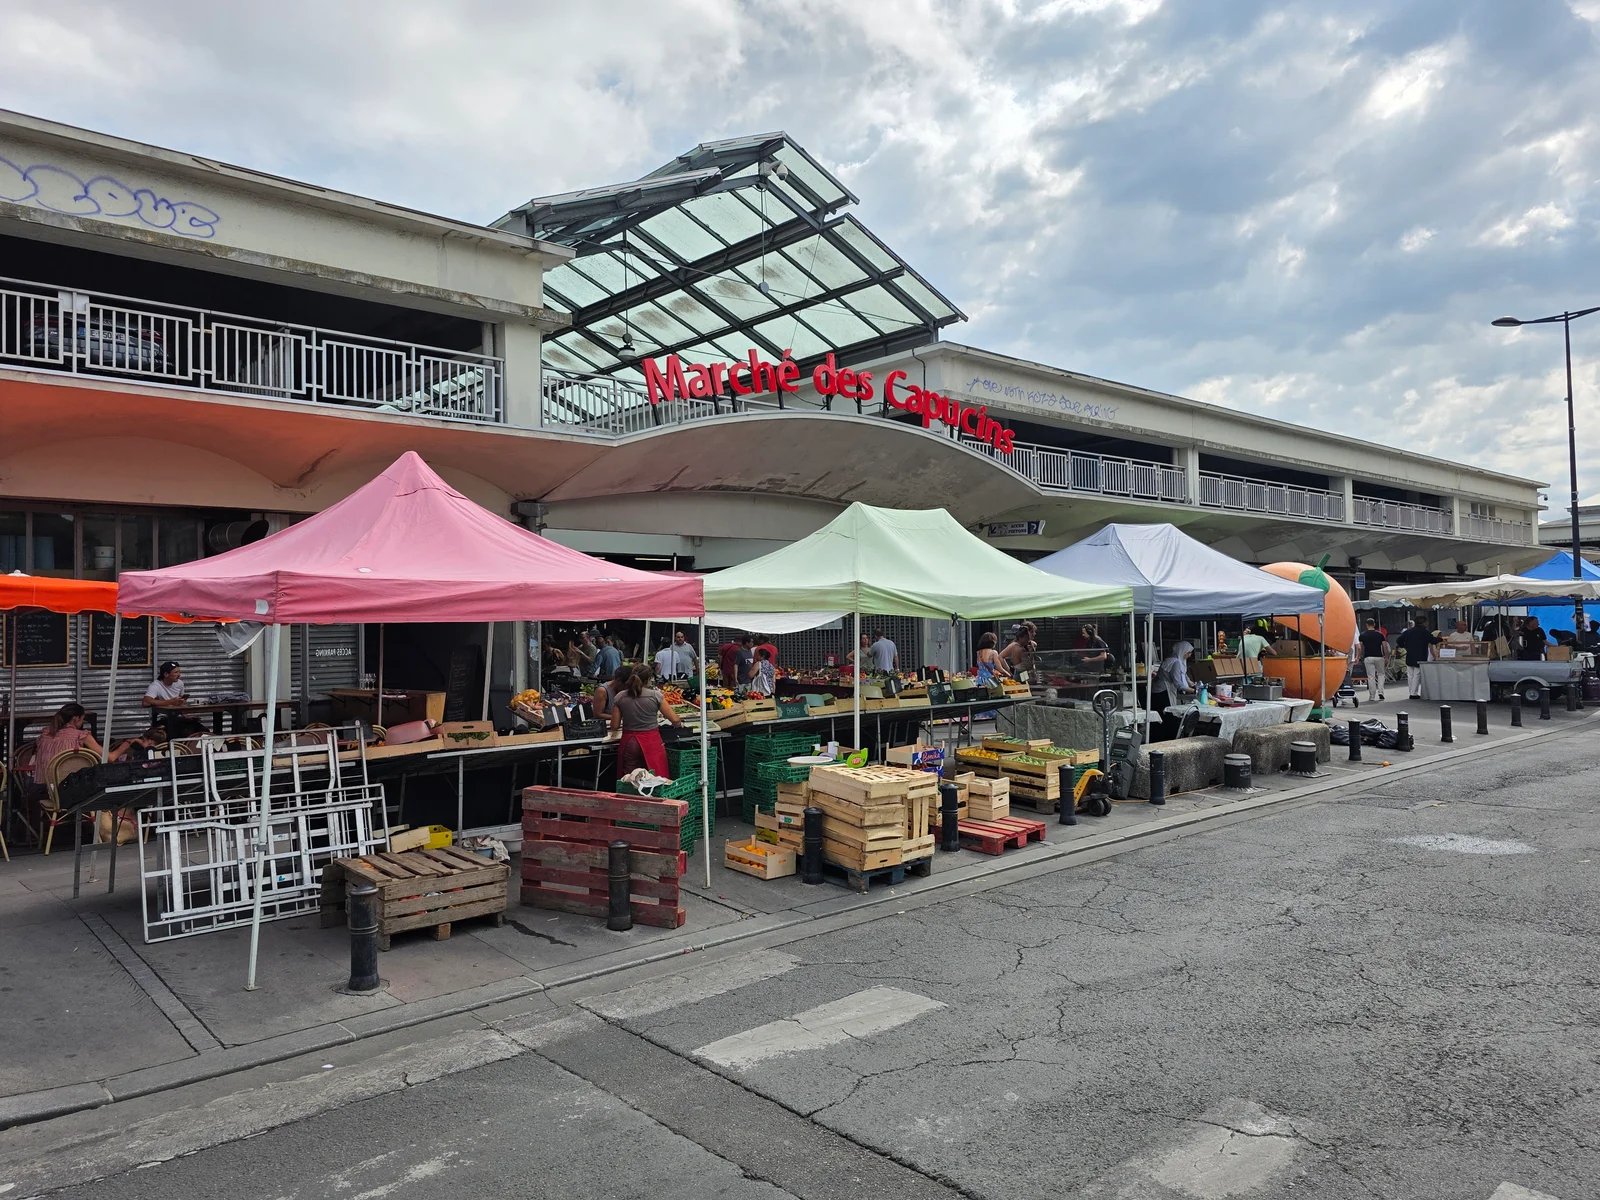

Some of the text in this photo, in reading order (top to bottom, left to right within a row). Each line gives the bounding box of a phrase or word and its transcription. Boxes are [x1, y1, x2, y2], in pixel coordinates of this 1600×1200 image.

[641, 348, 800, 405] Marché
[813, 352, 874, 400] des
[885, 370, 1016, 454] Capucins
